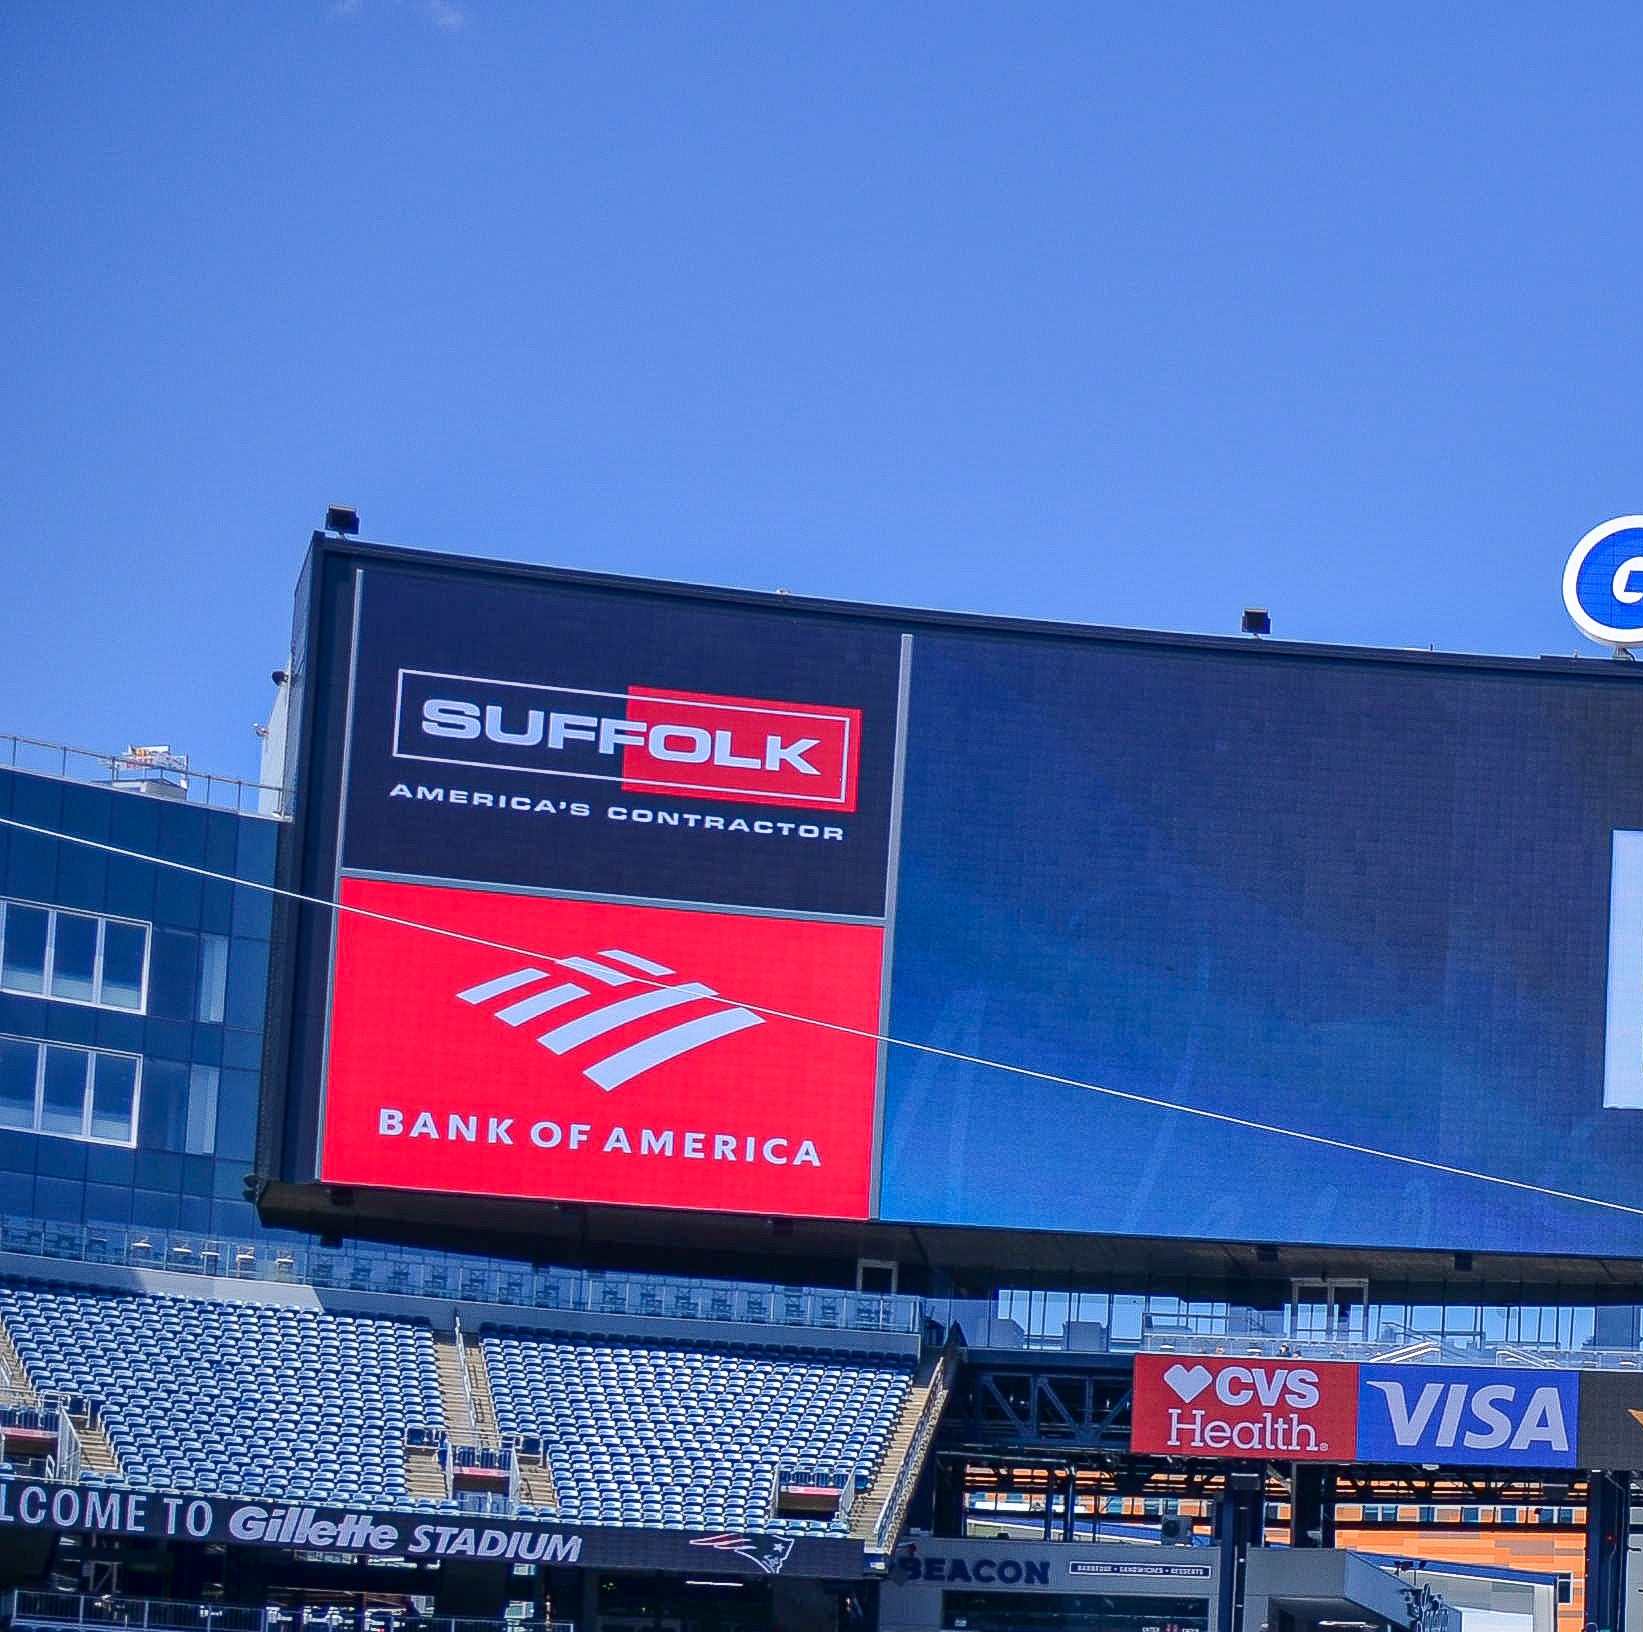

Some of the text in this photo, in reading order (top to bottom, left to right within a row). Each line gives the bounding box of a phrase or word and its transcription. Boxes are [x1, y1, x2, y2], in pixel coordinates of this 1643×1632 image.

[421, 698, 821, 776] SUFFOLK
[390, 783, 844, 842] AMERICA'S CONTRACTOR
[378, 1107, 823, 1168] BANK OF AMERICA
[1214, 1365, 1321, 1409] CVS
[1365, 1380, 1570, 1453] VISA
[1167, 1407, 1320, 1452] Health
[163, 1497, 213, 1538] TO
[228, 1504, 400, 1551] Gillette
[407, 1524, 584, 1564] STADIUM
[903, 1558, 1050, 1585] BEACON
